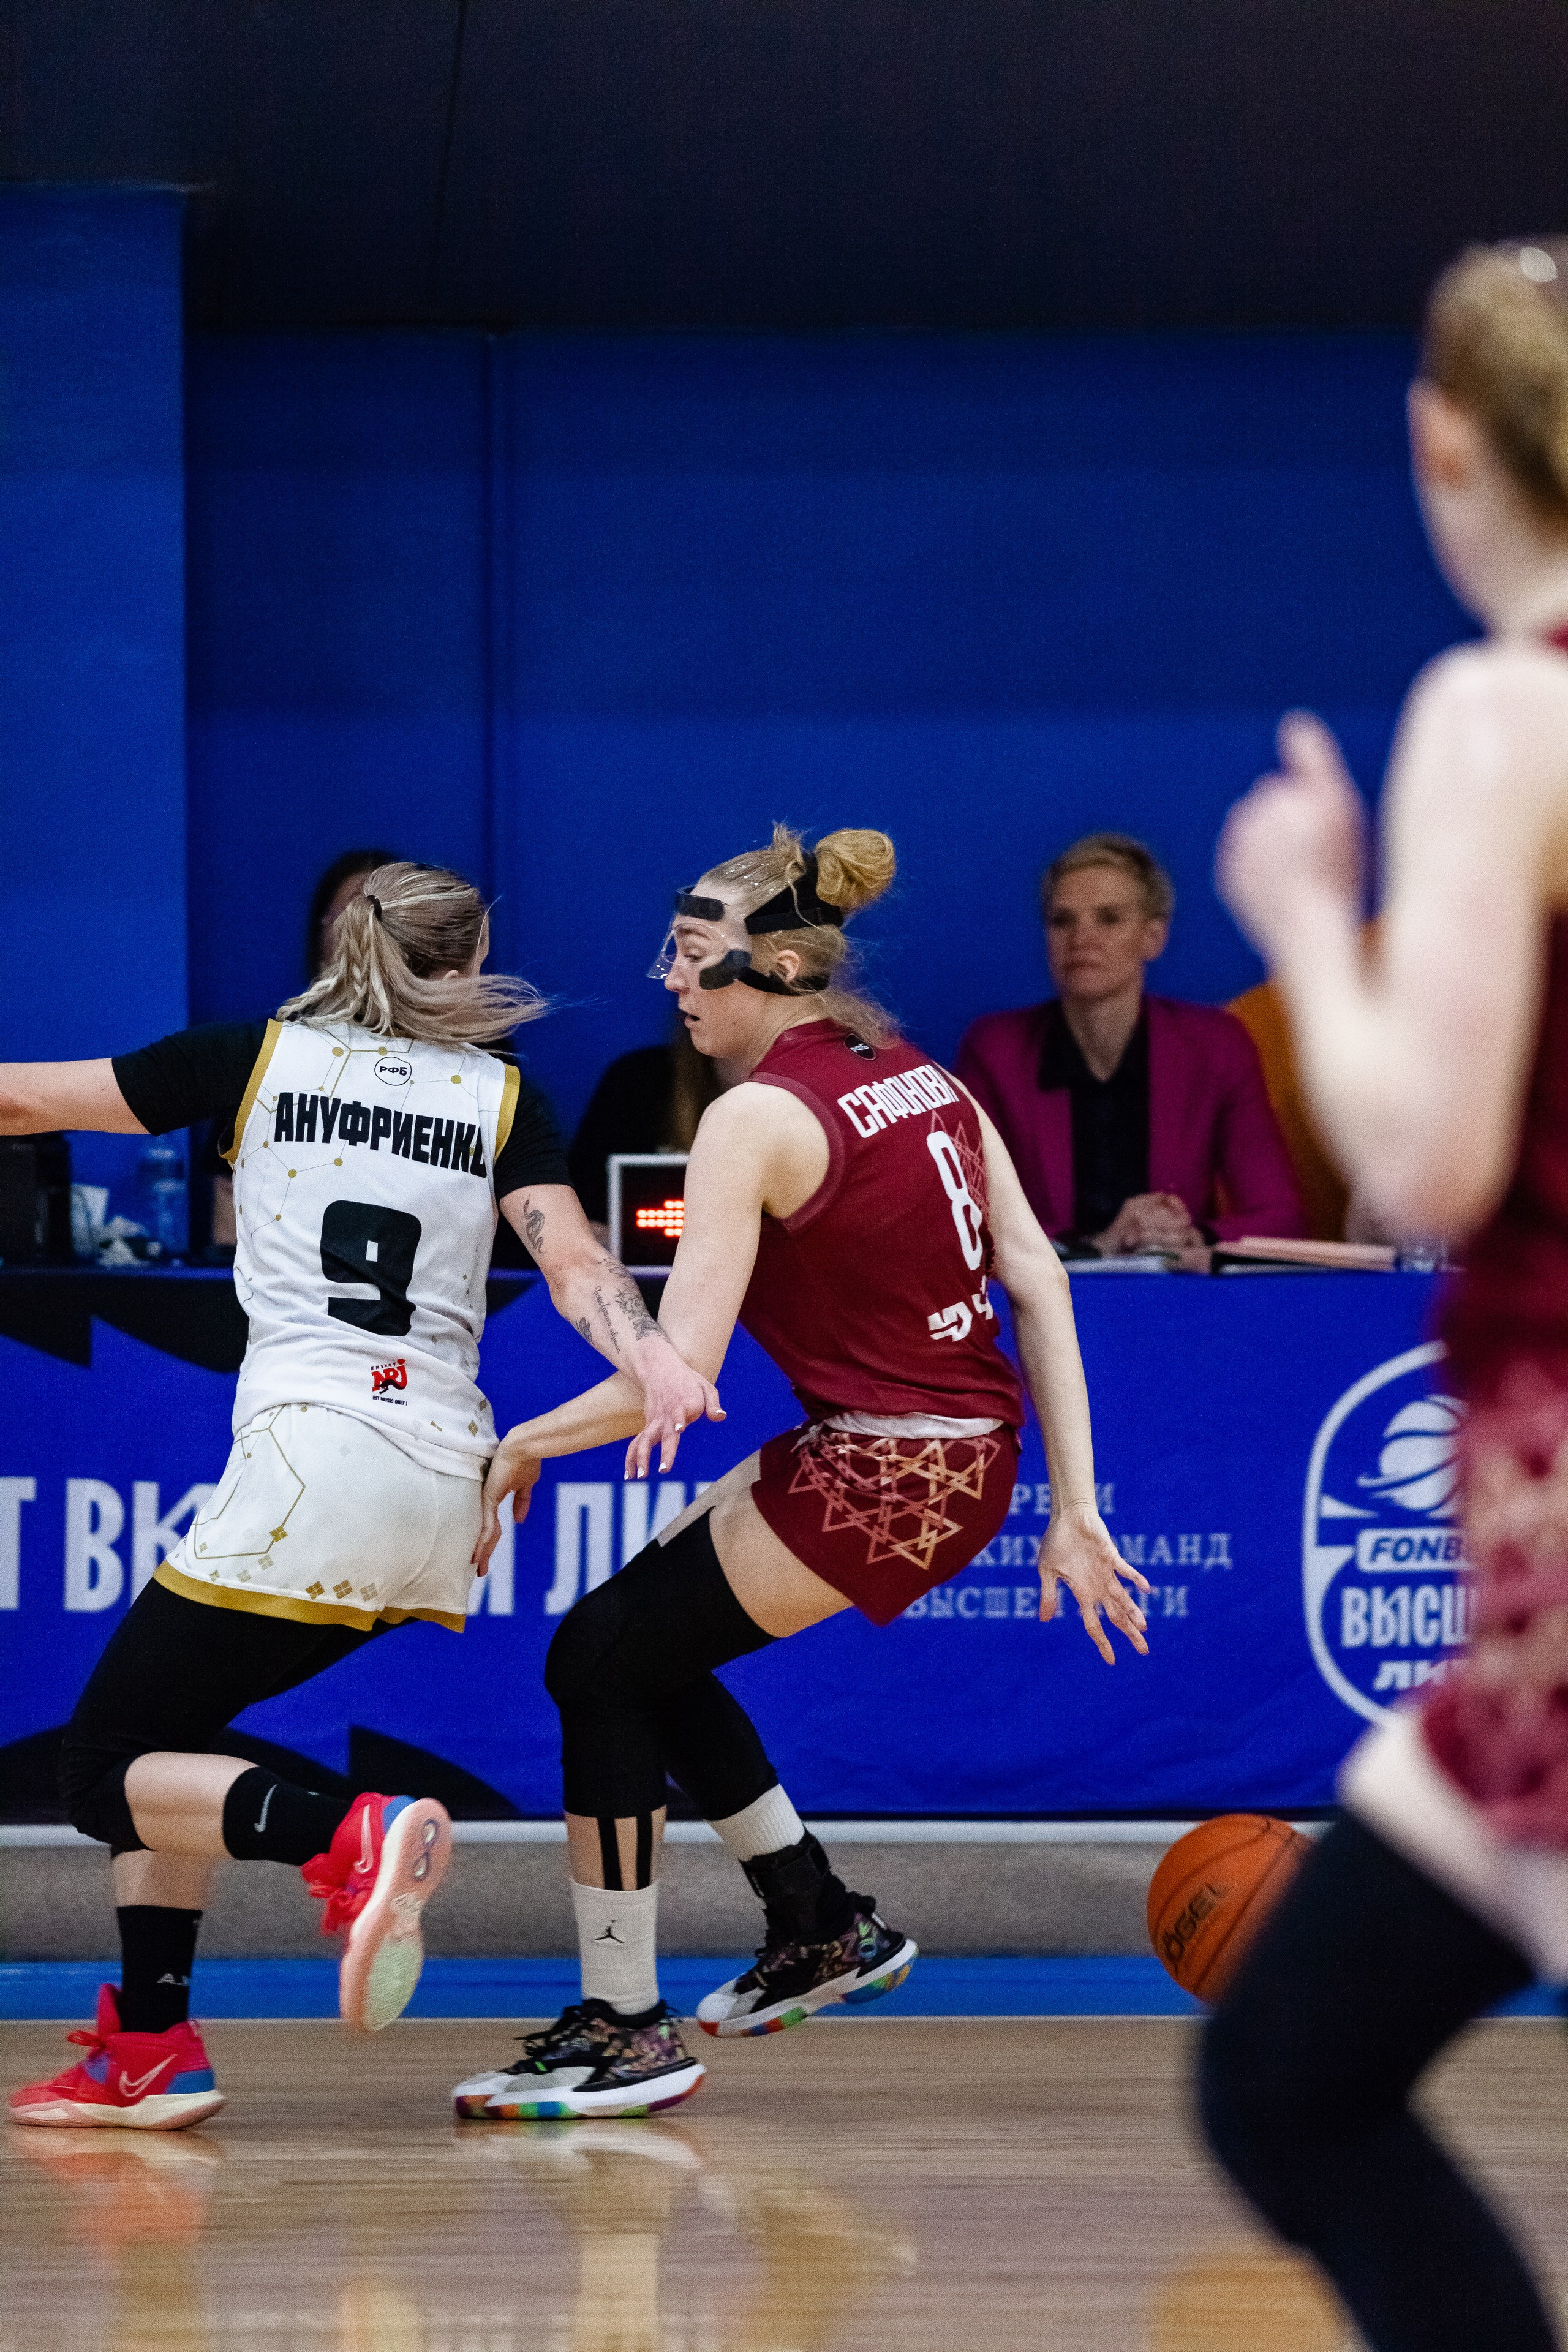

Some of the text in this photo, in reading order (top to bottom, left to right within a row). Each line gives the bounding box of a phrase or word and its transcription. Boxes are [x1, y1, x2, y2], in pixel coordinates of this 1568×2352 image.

[379, 1066, 407, 1076] РФБ
[837, 1064, 960, 1139] САФОНОВА
[926, 1131, 983, 1271] 8
[320, 1200, 422, 1336] 9
[371, 1359, 408, 1392] NRJ
[1370, 1536, 1464, 1562] FONB
[1341, 1584, 1477, 1648] ВЫСШ
